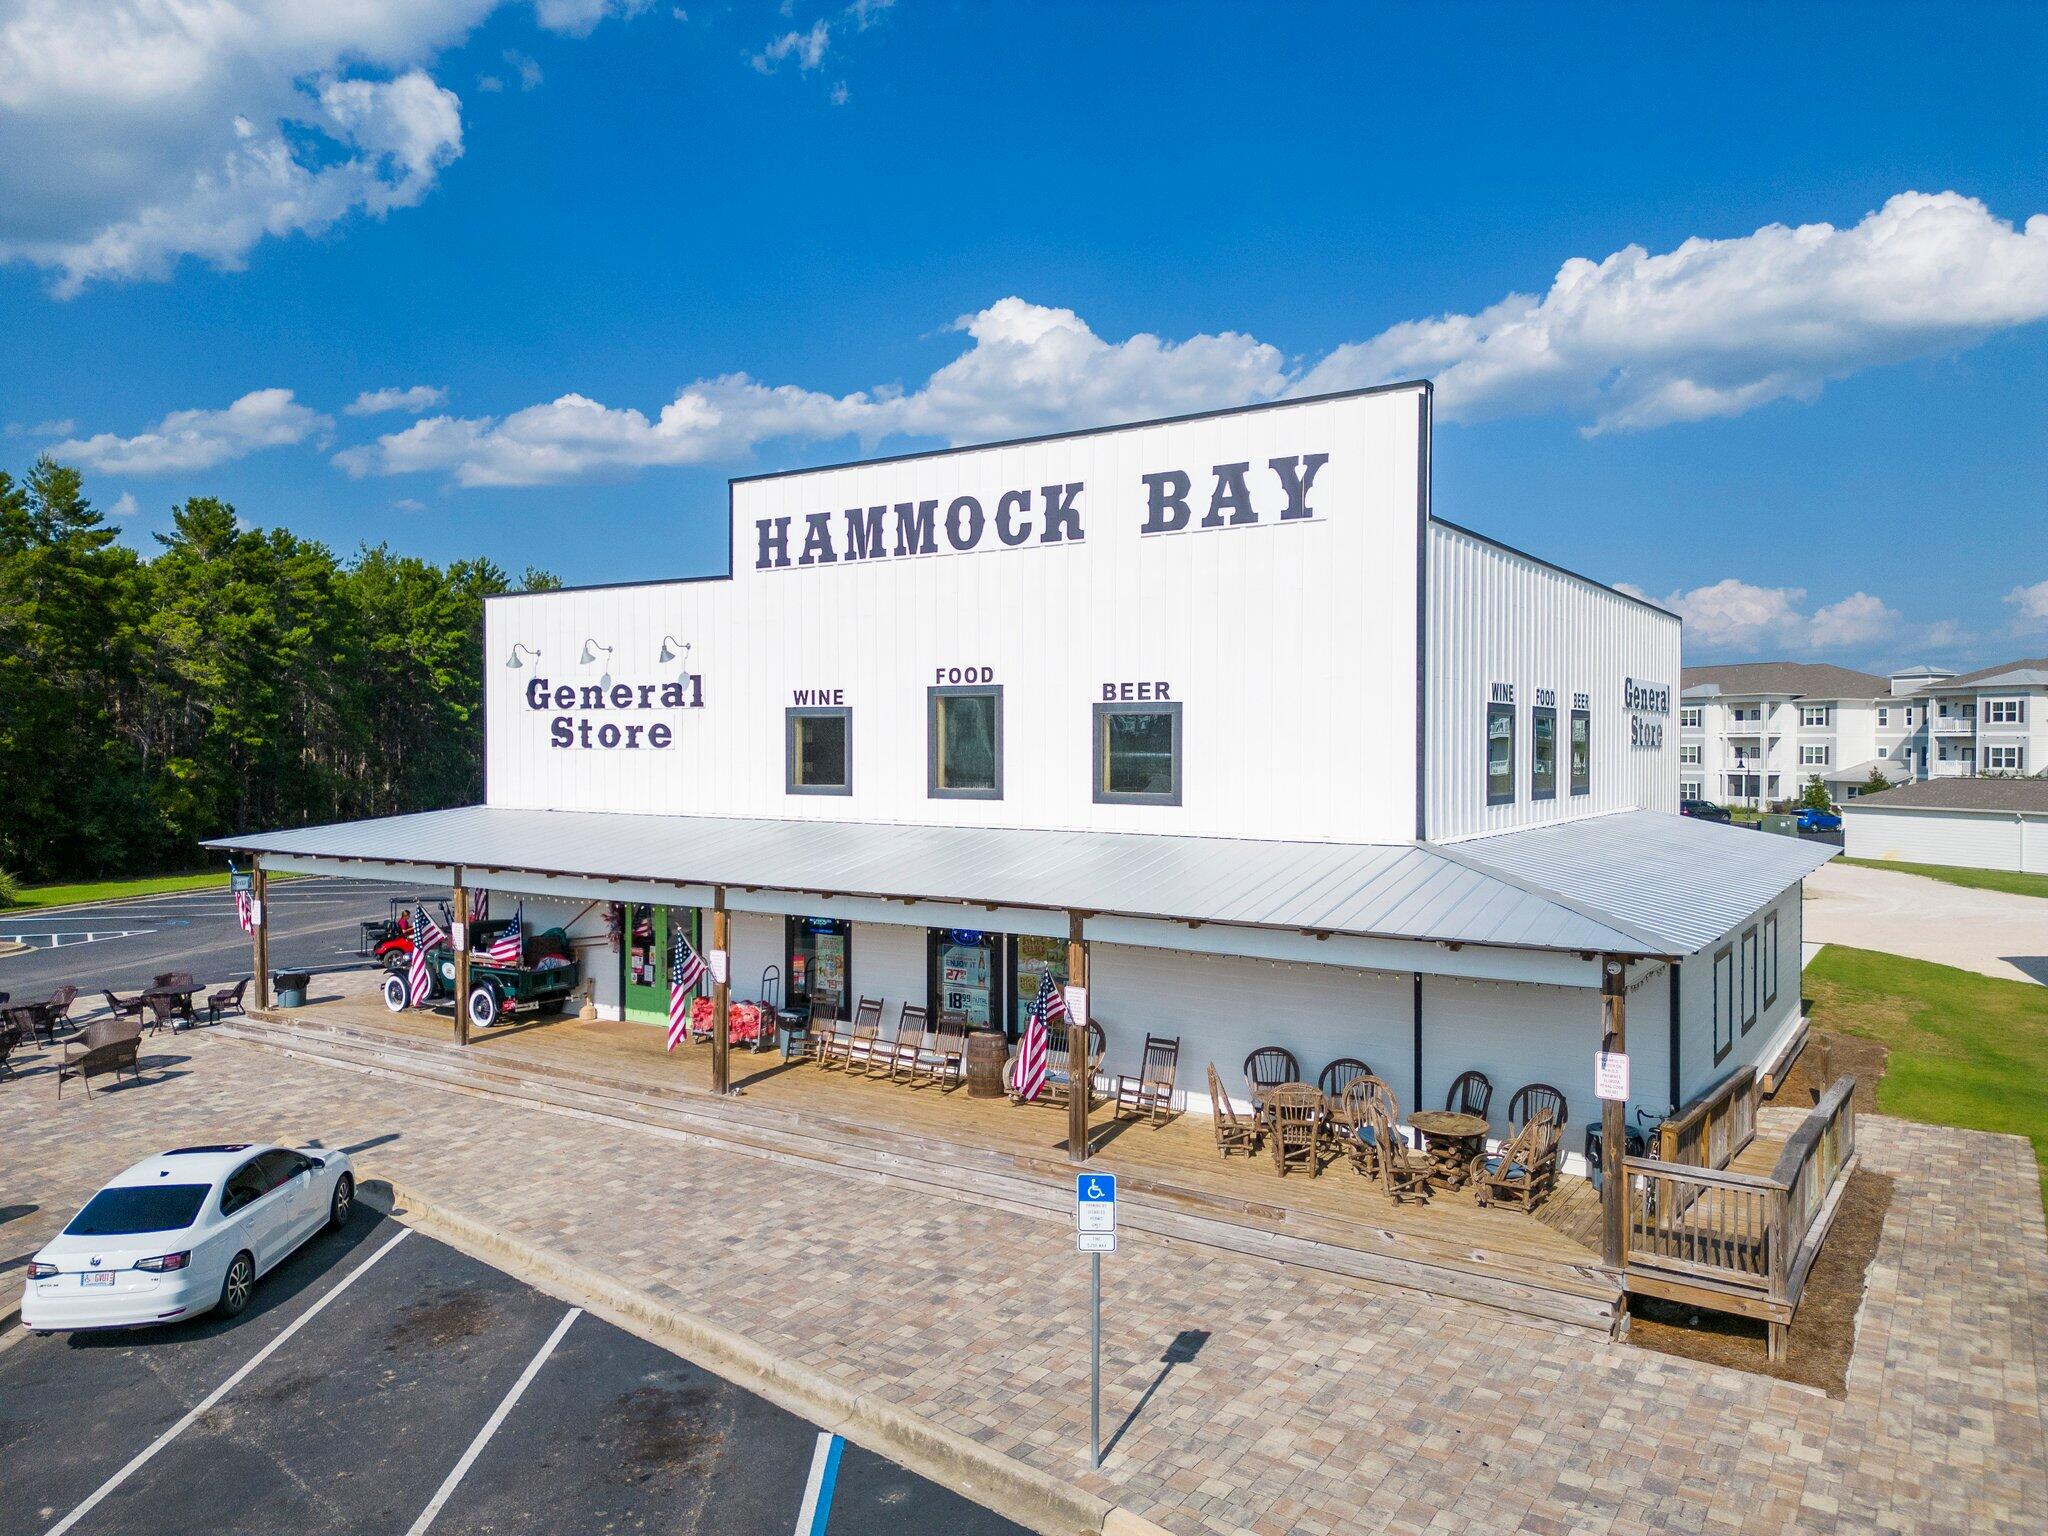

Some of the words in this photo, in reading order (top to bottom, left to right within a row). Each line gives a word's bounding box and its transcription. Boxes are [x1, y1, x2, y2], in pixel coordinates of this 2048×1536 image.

[756, 482, 1084, 570] HAMMOCK
[1141, 453, 1329, 534] BAY
[936, 667, 994, 685] FOOD
[526, 675, 704, 710] General
[793, 689, 844, 706] WINE
[1102, 682, 1171, 701] BEER
[1491, 682, 1514, 703] WINE
[1536, 689, 1555, 706] FOOD
[1573, 693, 1590, 709] BEER
[1625, 677, 1670, 713] General
[551, 717, 672, 749] Store
[1631, 715, 1663, 747] Store
